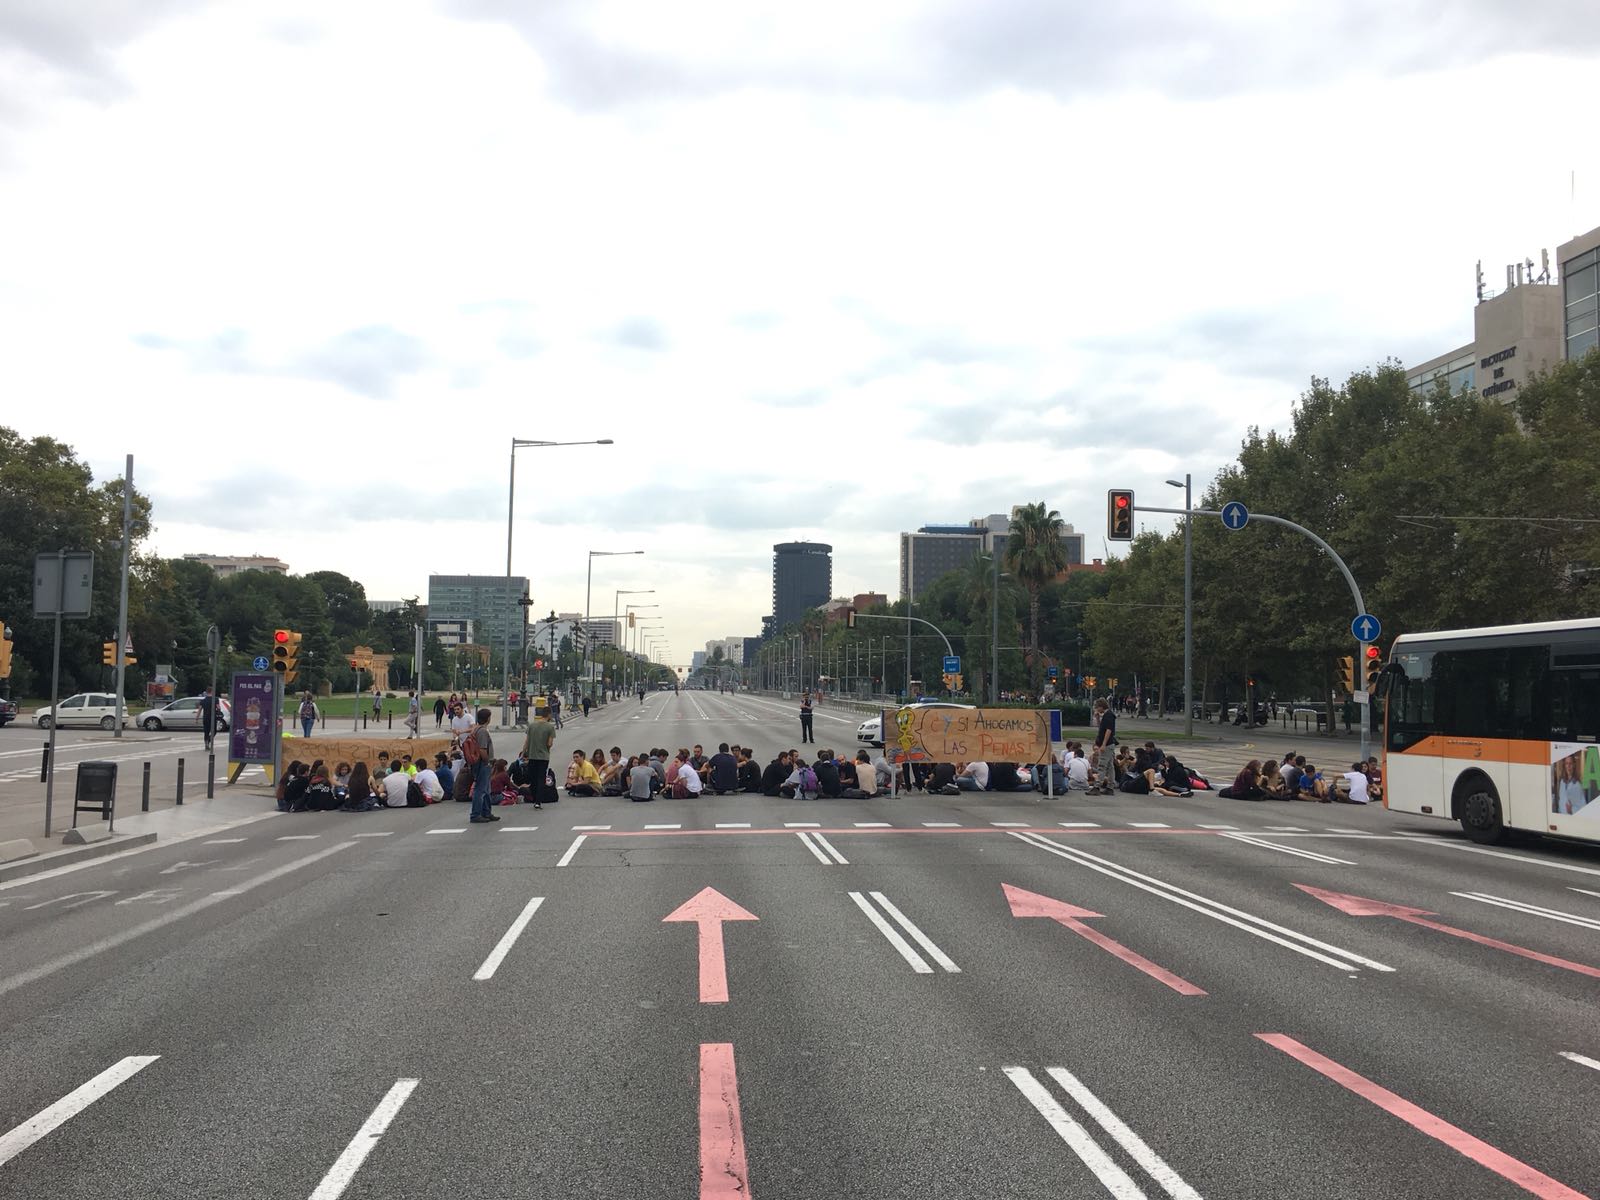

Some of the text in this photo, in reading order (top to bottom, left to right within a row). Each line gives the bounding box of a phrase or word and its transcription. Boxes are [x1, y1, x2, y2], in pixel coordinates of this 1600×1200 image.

[958, 716, 969, 732] SI
[974, 710, 1034, 732] AHOGAMOS
[943, 731, 1037, 757] LAS PENAS?
